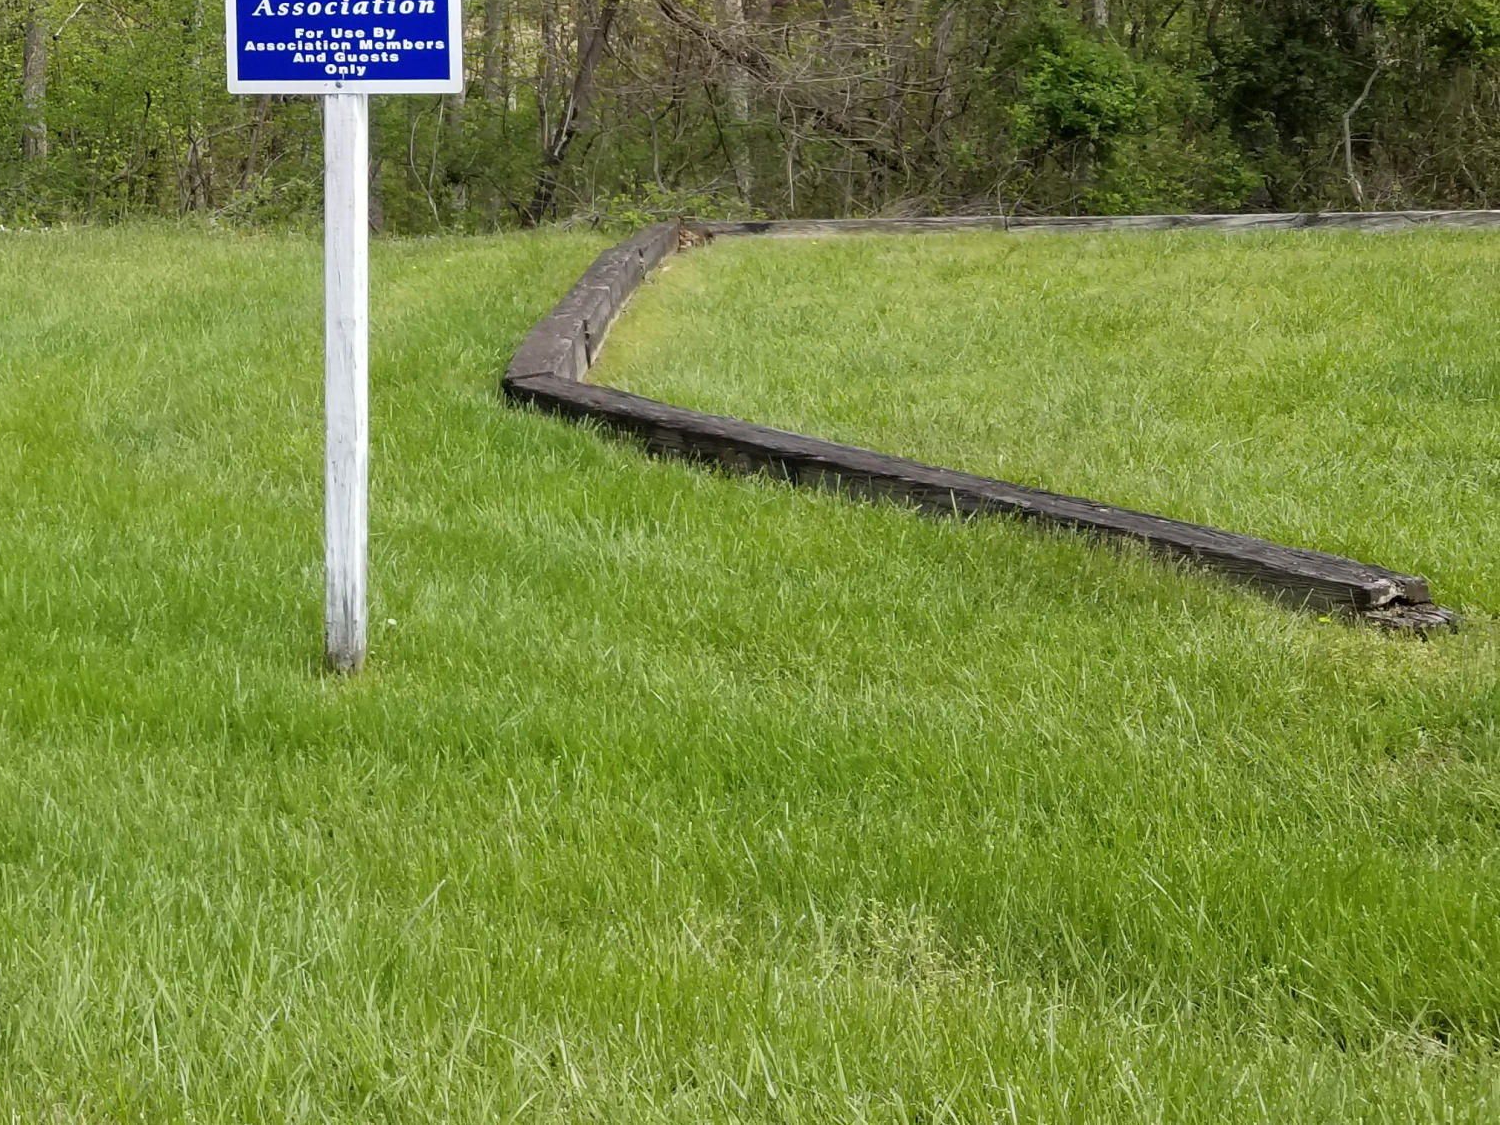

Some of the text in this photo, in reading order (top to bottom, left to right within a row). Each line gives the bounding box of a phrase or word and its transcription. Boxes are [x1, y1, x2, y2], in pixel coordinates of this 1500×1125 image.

[294, 27, 396, 39] For Use By
[244, 39, 445, 51] Association Members
[293, 52, 399, 63] And Guests
[324, 64, 367, 76] Only
